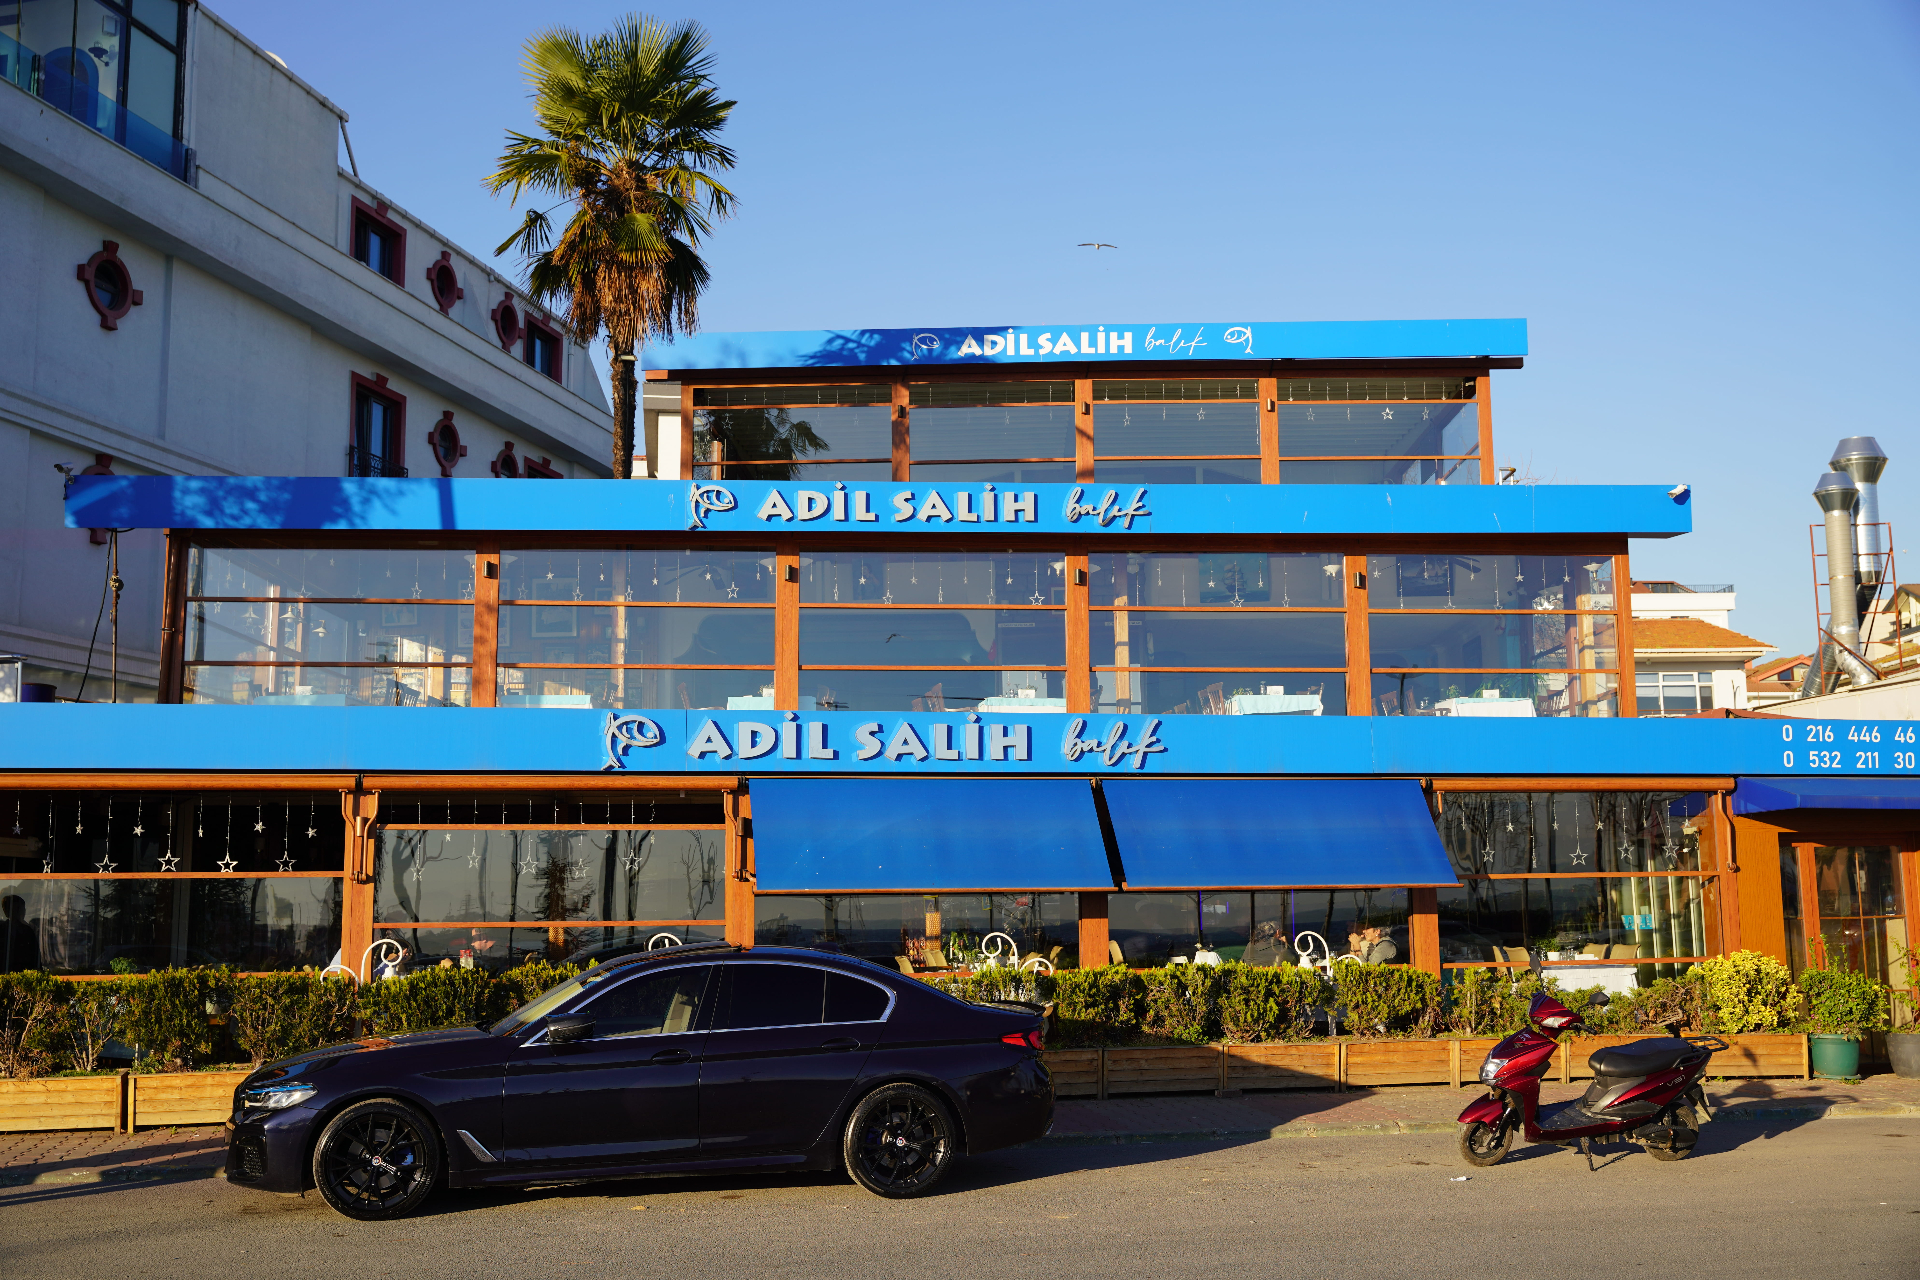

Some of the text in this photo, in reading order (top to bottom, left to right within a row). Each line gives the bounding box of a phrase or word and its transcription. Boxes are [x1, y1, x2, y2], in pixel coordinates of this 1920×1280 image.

[756, 481, 877, 522] ADİL
[892, 482, 1037, 522] SALİH
[686, 711, 835, 760] ADİL
[854, 713, 1031, 761] SALİH
[1782, 724, 1916, 743] 0 216 446 46
[1783, 750, 1916, 769] 0 532 211 30
